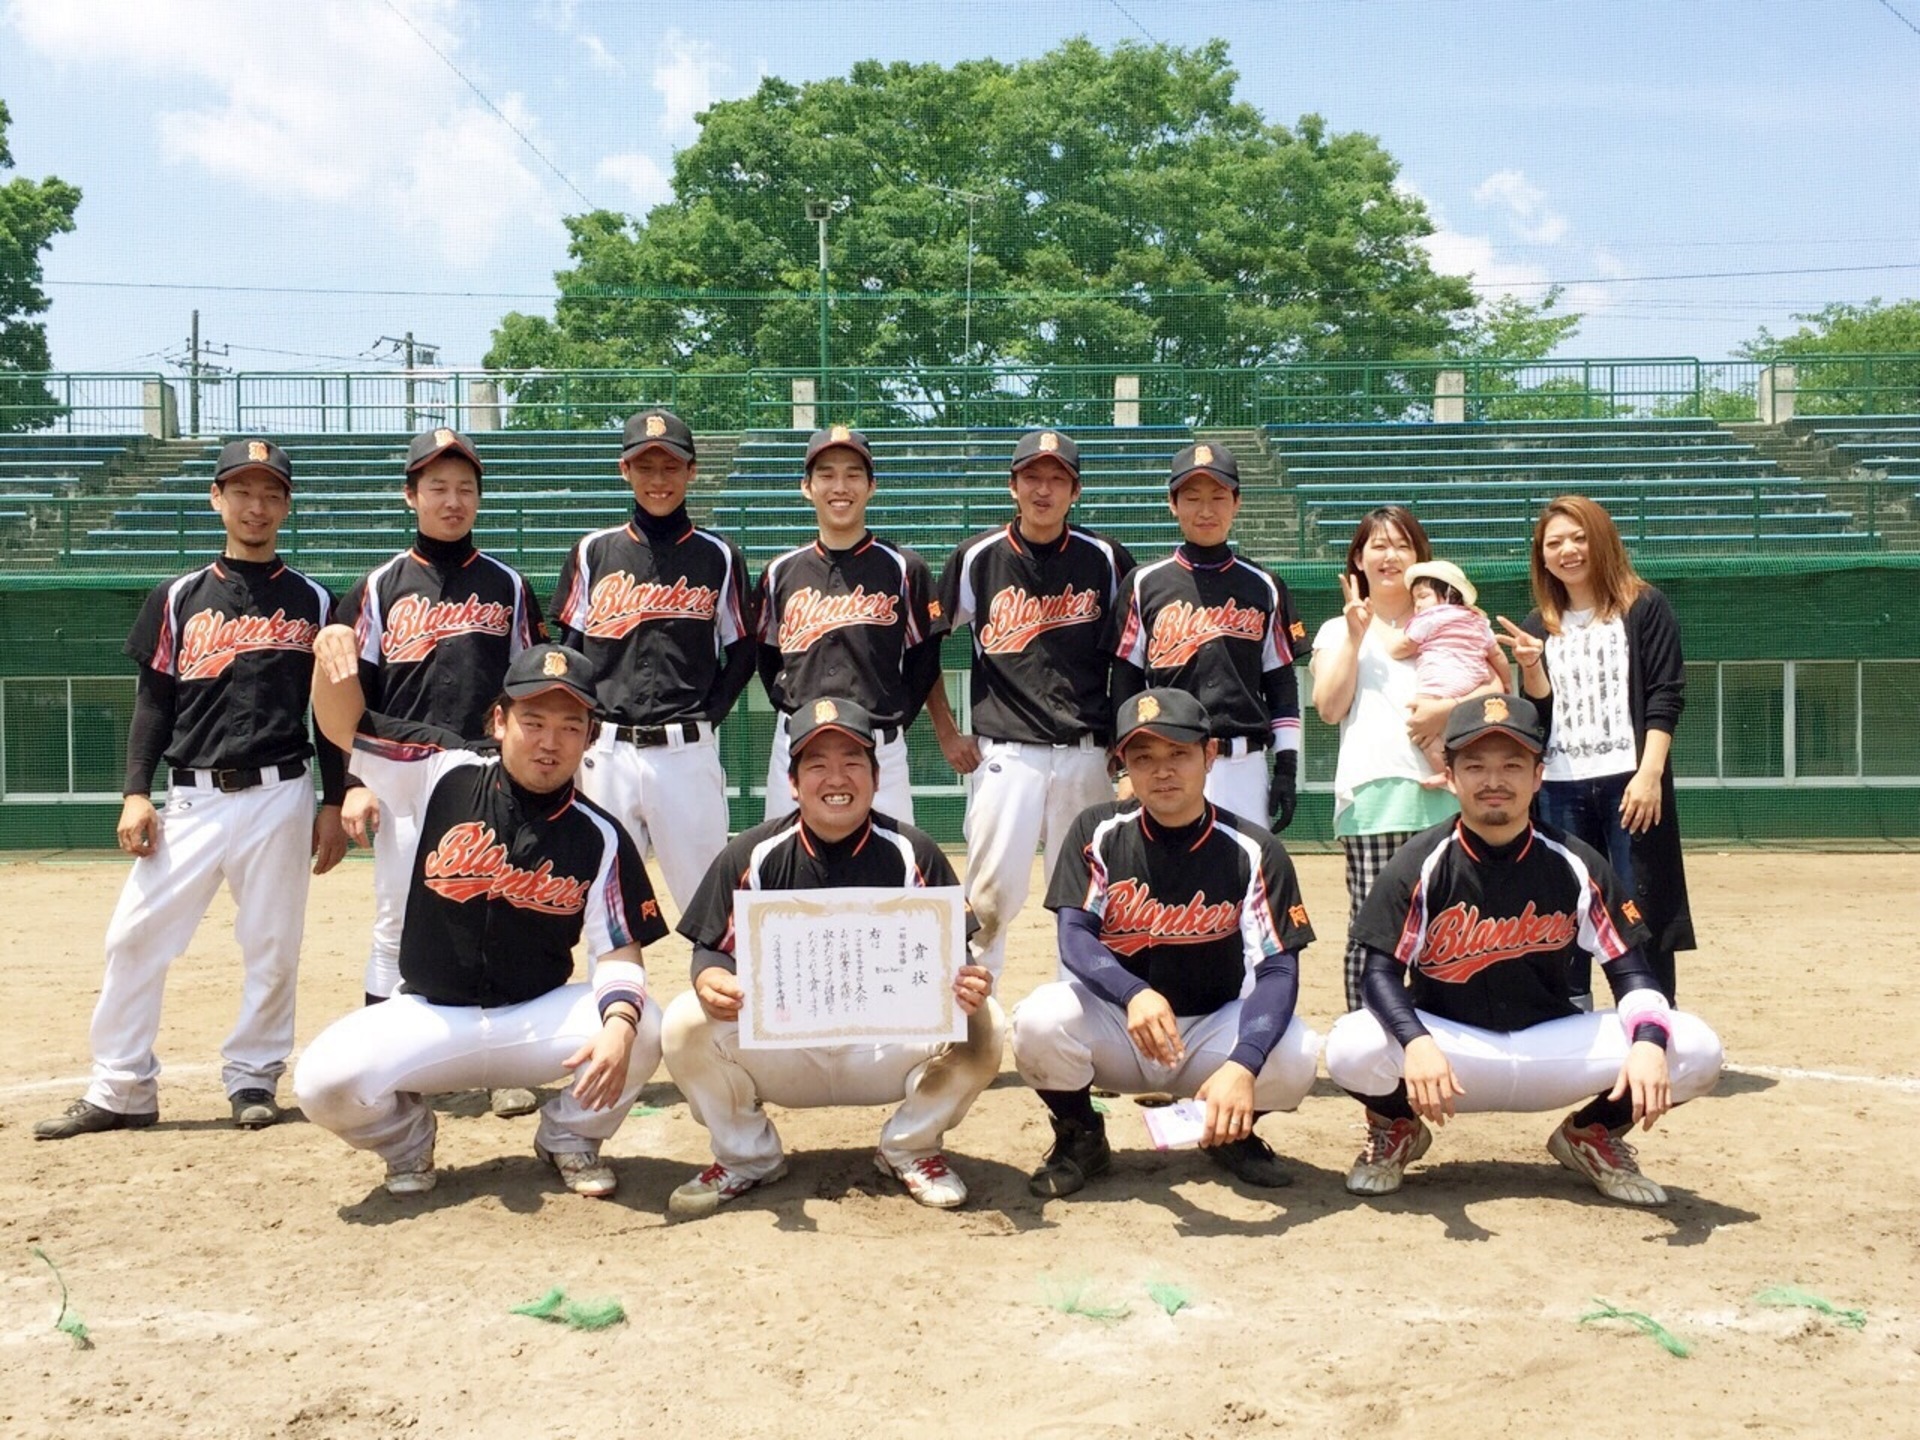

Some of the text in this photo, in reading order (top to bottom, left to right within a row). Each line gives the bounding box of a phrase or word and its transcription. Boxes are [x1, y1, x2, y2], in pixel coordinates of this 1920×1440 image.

[381, 591, 514, 654] Blankers
[585, 569, 719, 626] Blankers
[779, 583, 899, 643] Blankers
[1149, 596, 1266, 659] Blankers
[178, 607, 319, 676] Blankers
[424, 820, 591, 907] Blankers
[1419, 900, 1578, 965] Blankers
